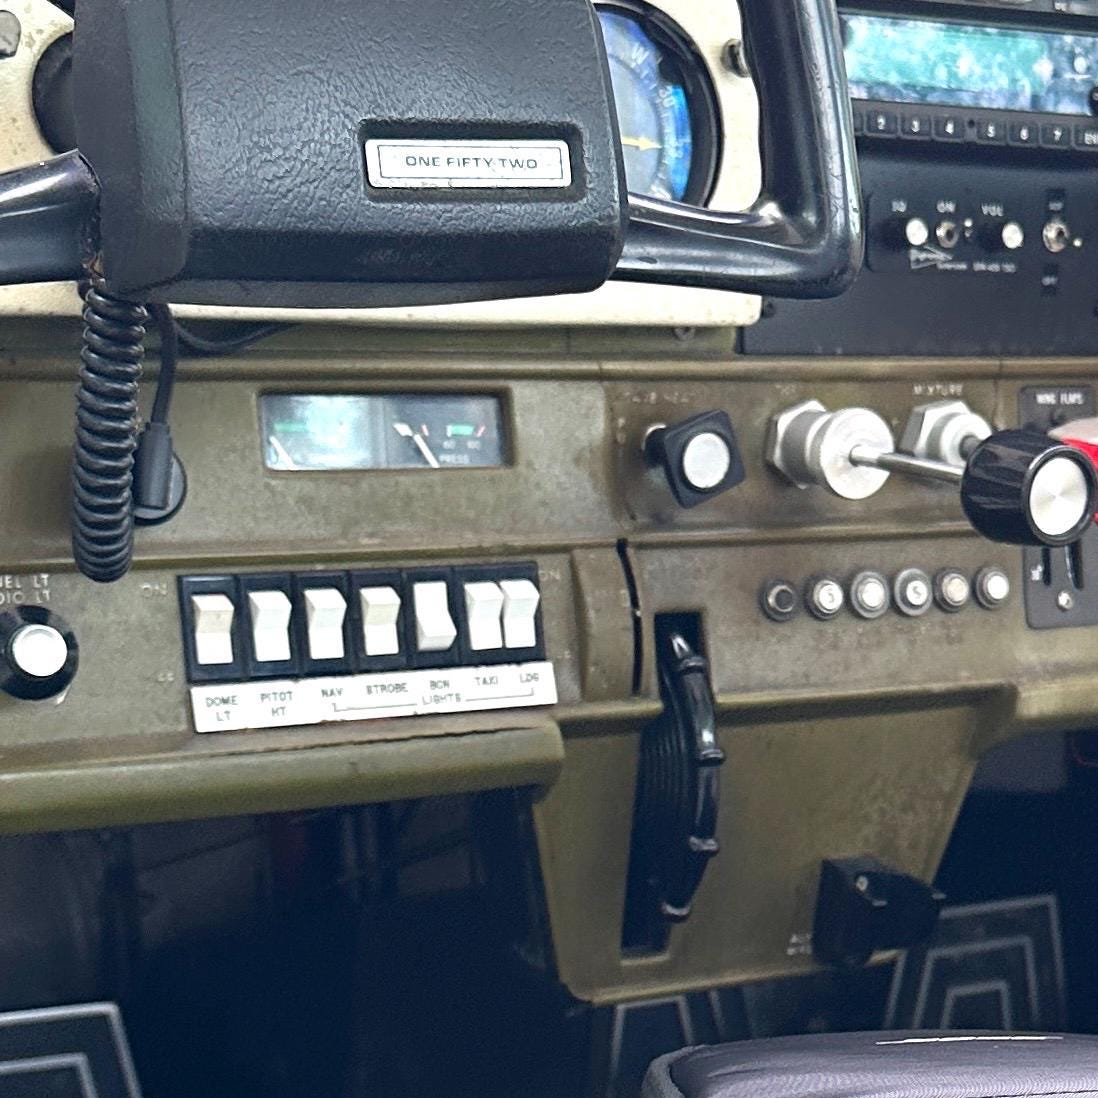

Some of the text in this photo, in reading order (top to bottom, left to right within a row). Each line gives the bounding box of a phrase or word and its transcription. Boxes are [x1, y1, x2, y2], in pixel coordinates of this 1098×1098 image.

[876, 114, 886, 130] 2
[910, 118, 921, 134] 3
[944, 121, 955, 134] 4
[986, 124, 996, 138] 5
[405, 155, 538, 169] ONE FIFTY TWO
[981, 204, 1004, 217] VOL
[32, 573, 49, 588] LT
[35, 589, 50, 604] LT
[205, 673, 539, 708] DOME PITOT NAV STROBE BCN TAXI LDG
[216, 693, 461, 721] LT HT LIGHTS
